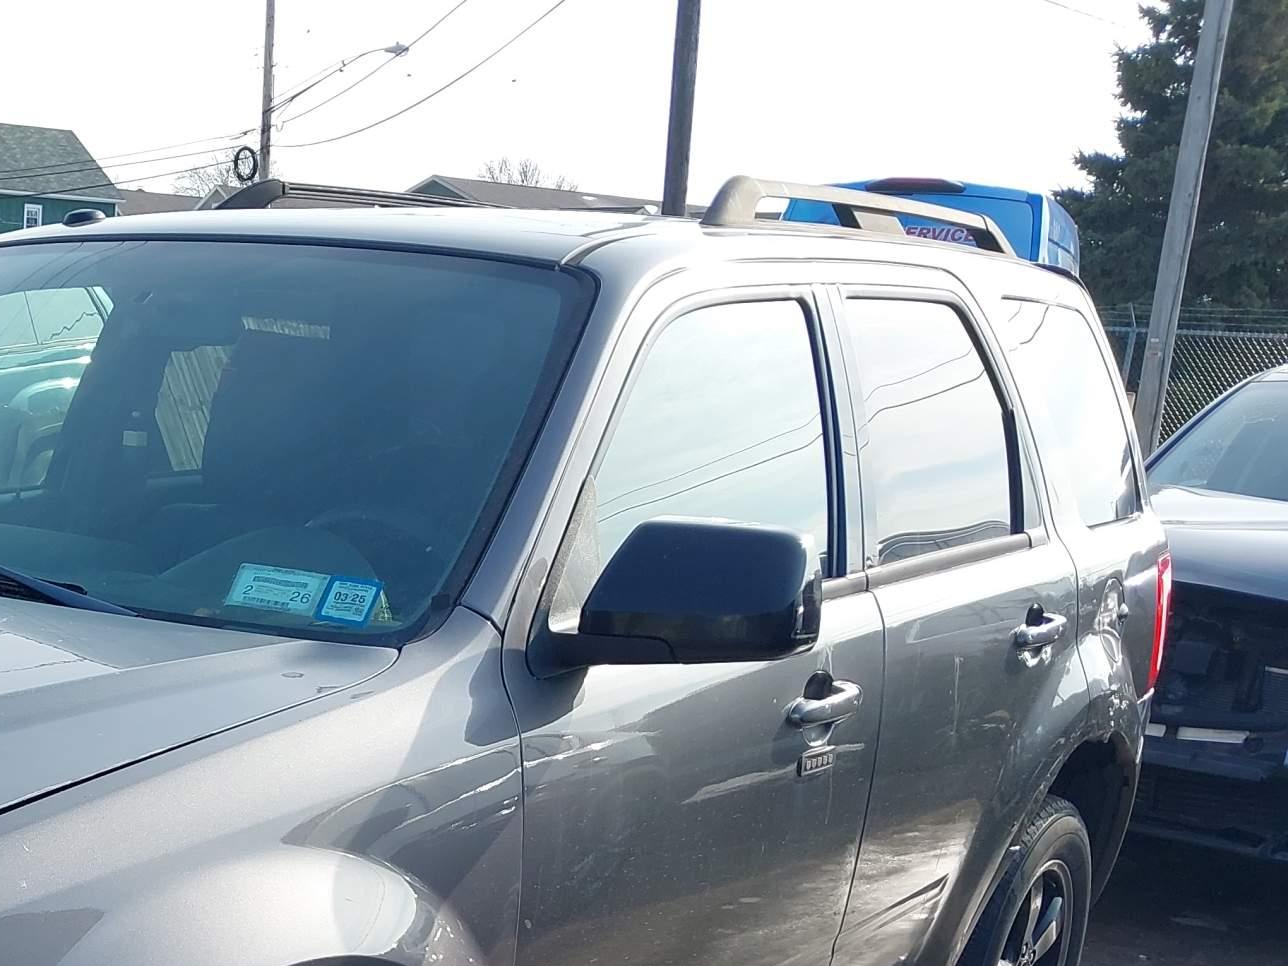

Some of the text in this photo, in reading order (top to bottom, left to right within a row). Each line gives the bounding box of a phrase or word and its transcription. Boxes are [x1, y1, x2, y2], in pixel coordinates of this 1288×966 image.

[905, 226, 976, 243] ERVICE
[242, 584, 254, 595] 2
[289, 591, 311, 604] 26
